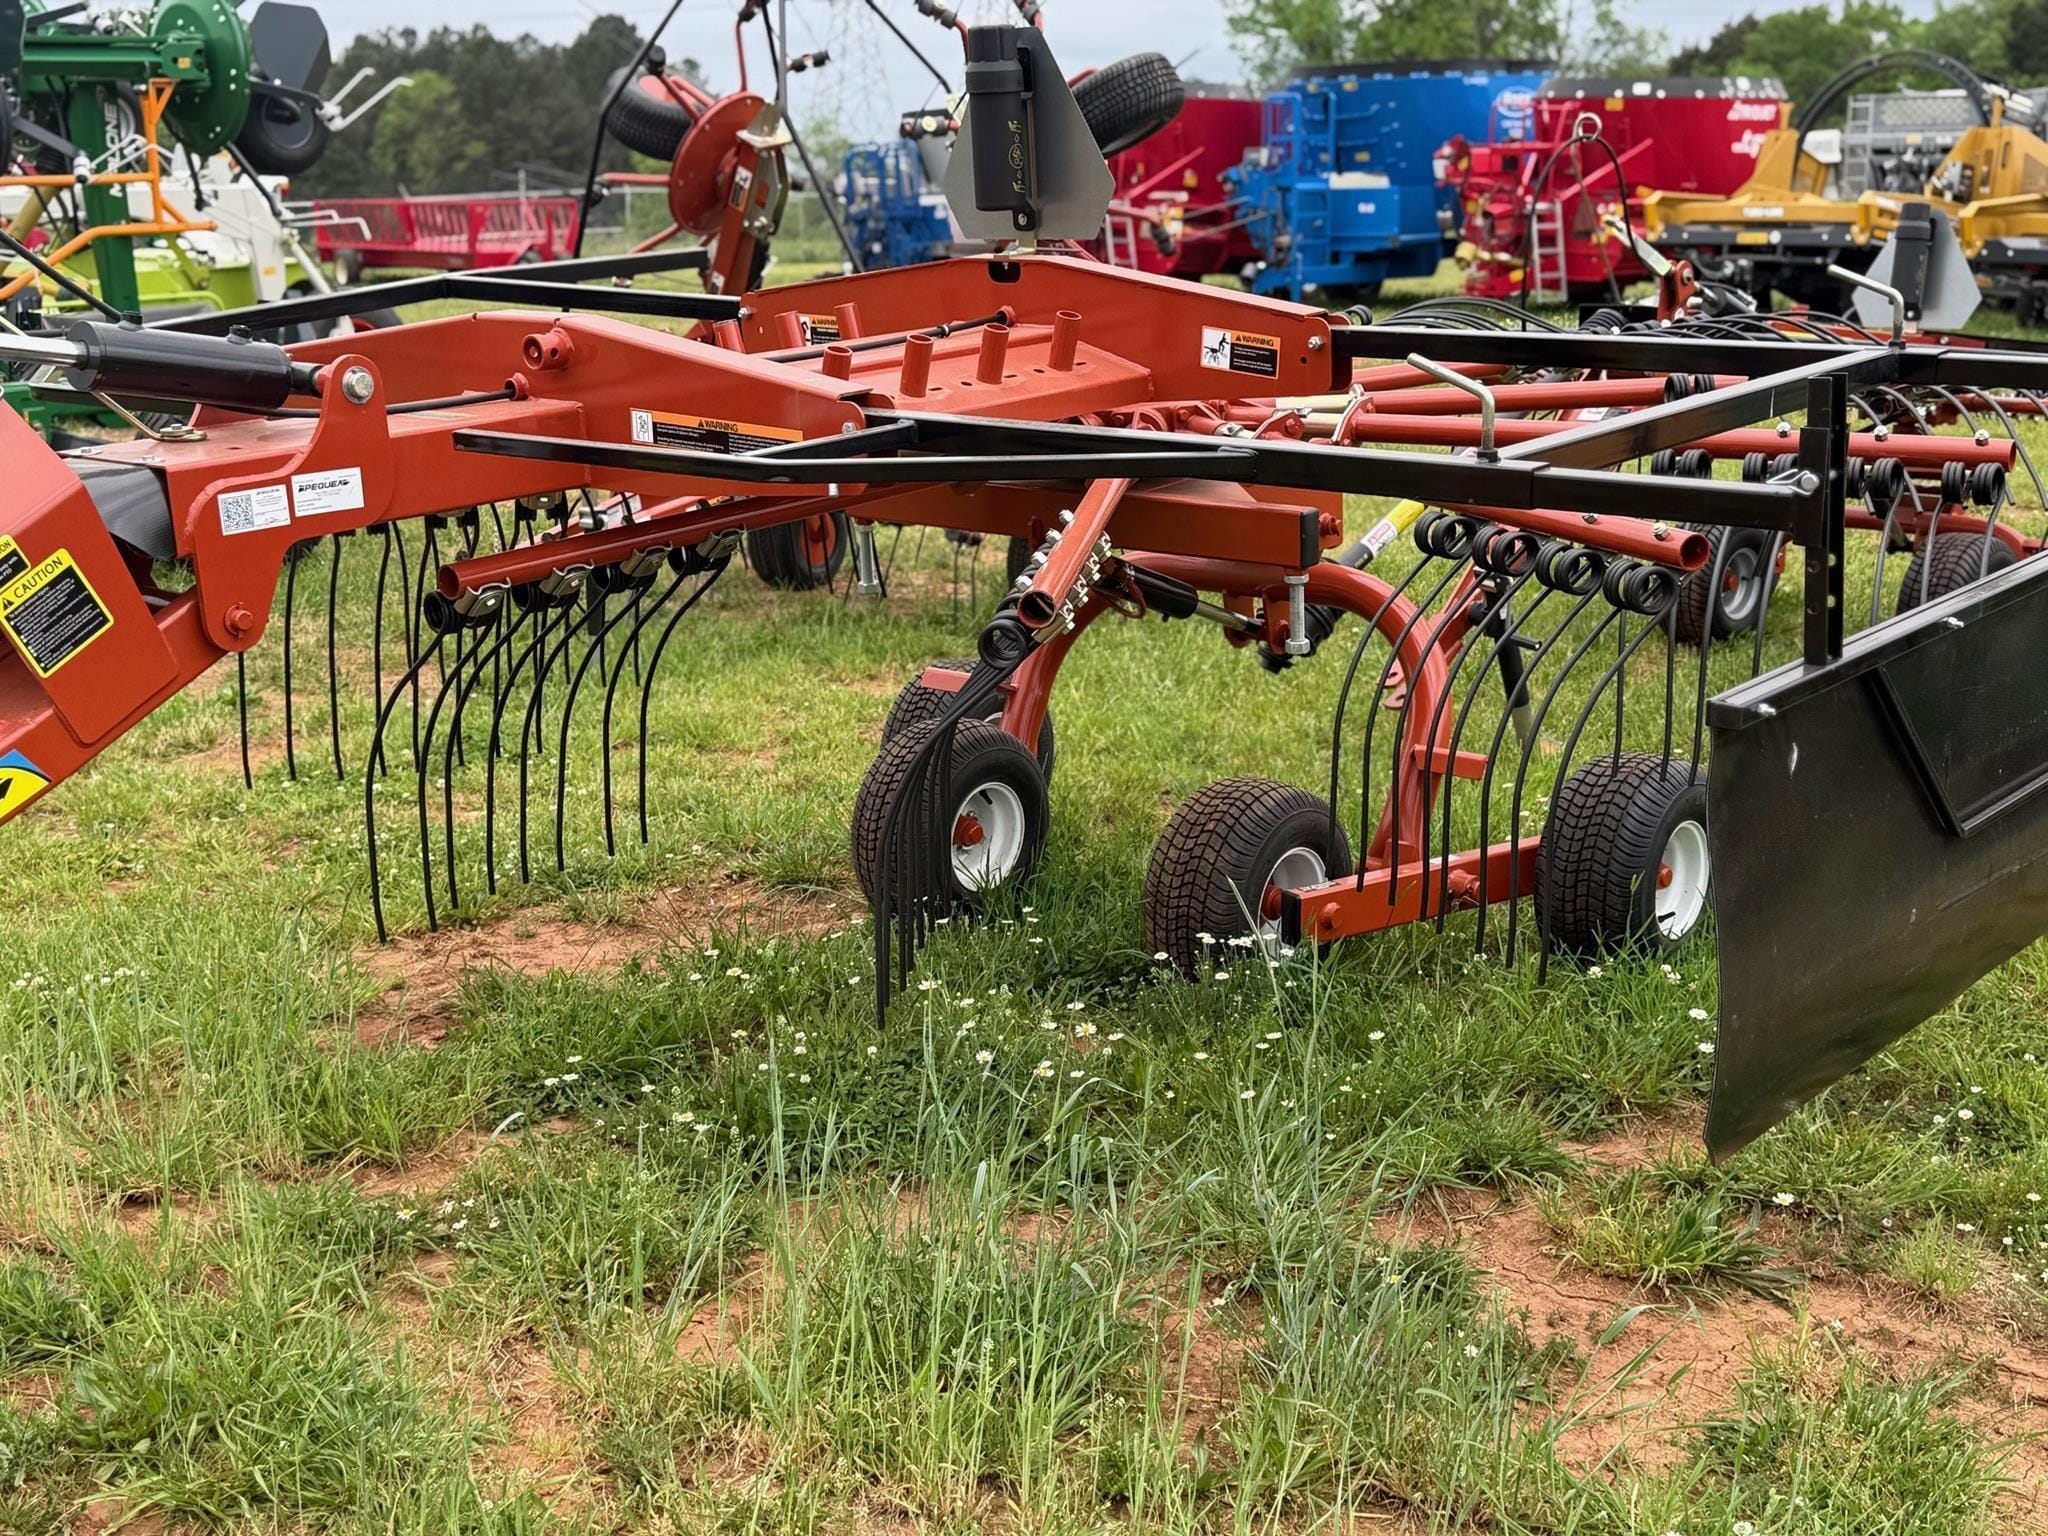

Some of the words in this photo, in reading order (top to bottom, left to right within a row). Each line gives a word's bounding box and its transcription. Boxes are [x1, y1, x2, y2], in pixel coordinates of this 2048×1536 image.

[1242, 334, 1274, 346] WARNING
[704, 419, 739, 432] WARNING
[14, 556, 64, 598] CAUTION
